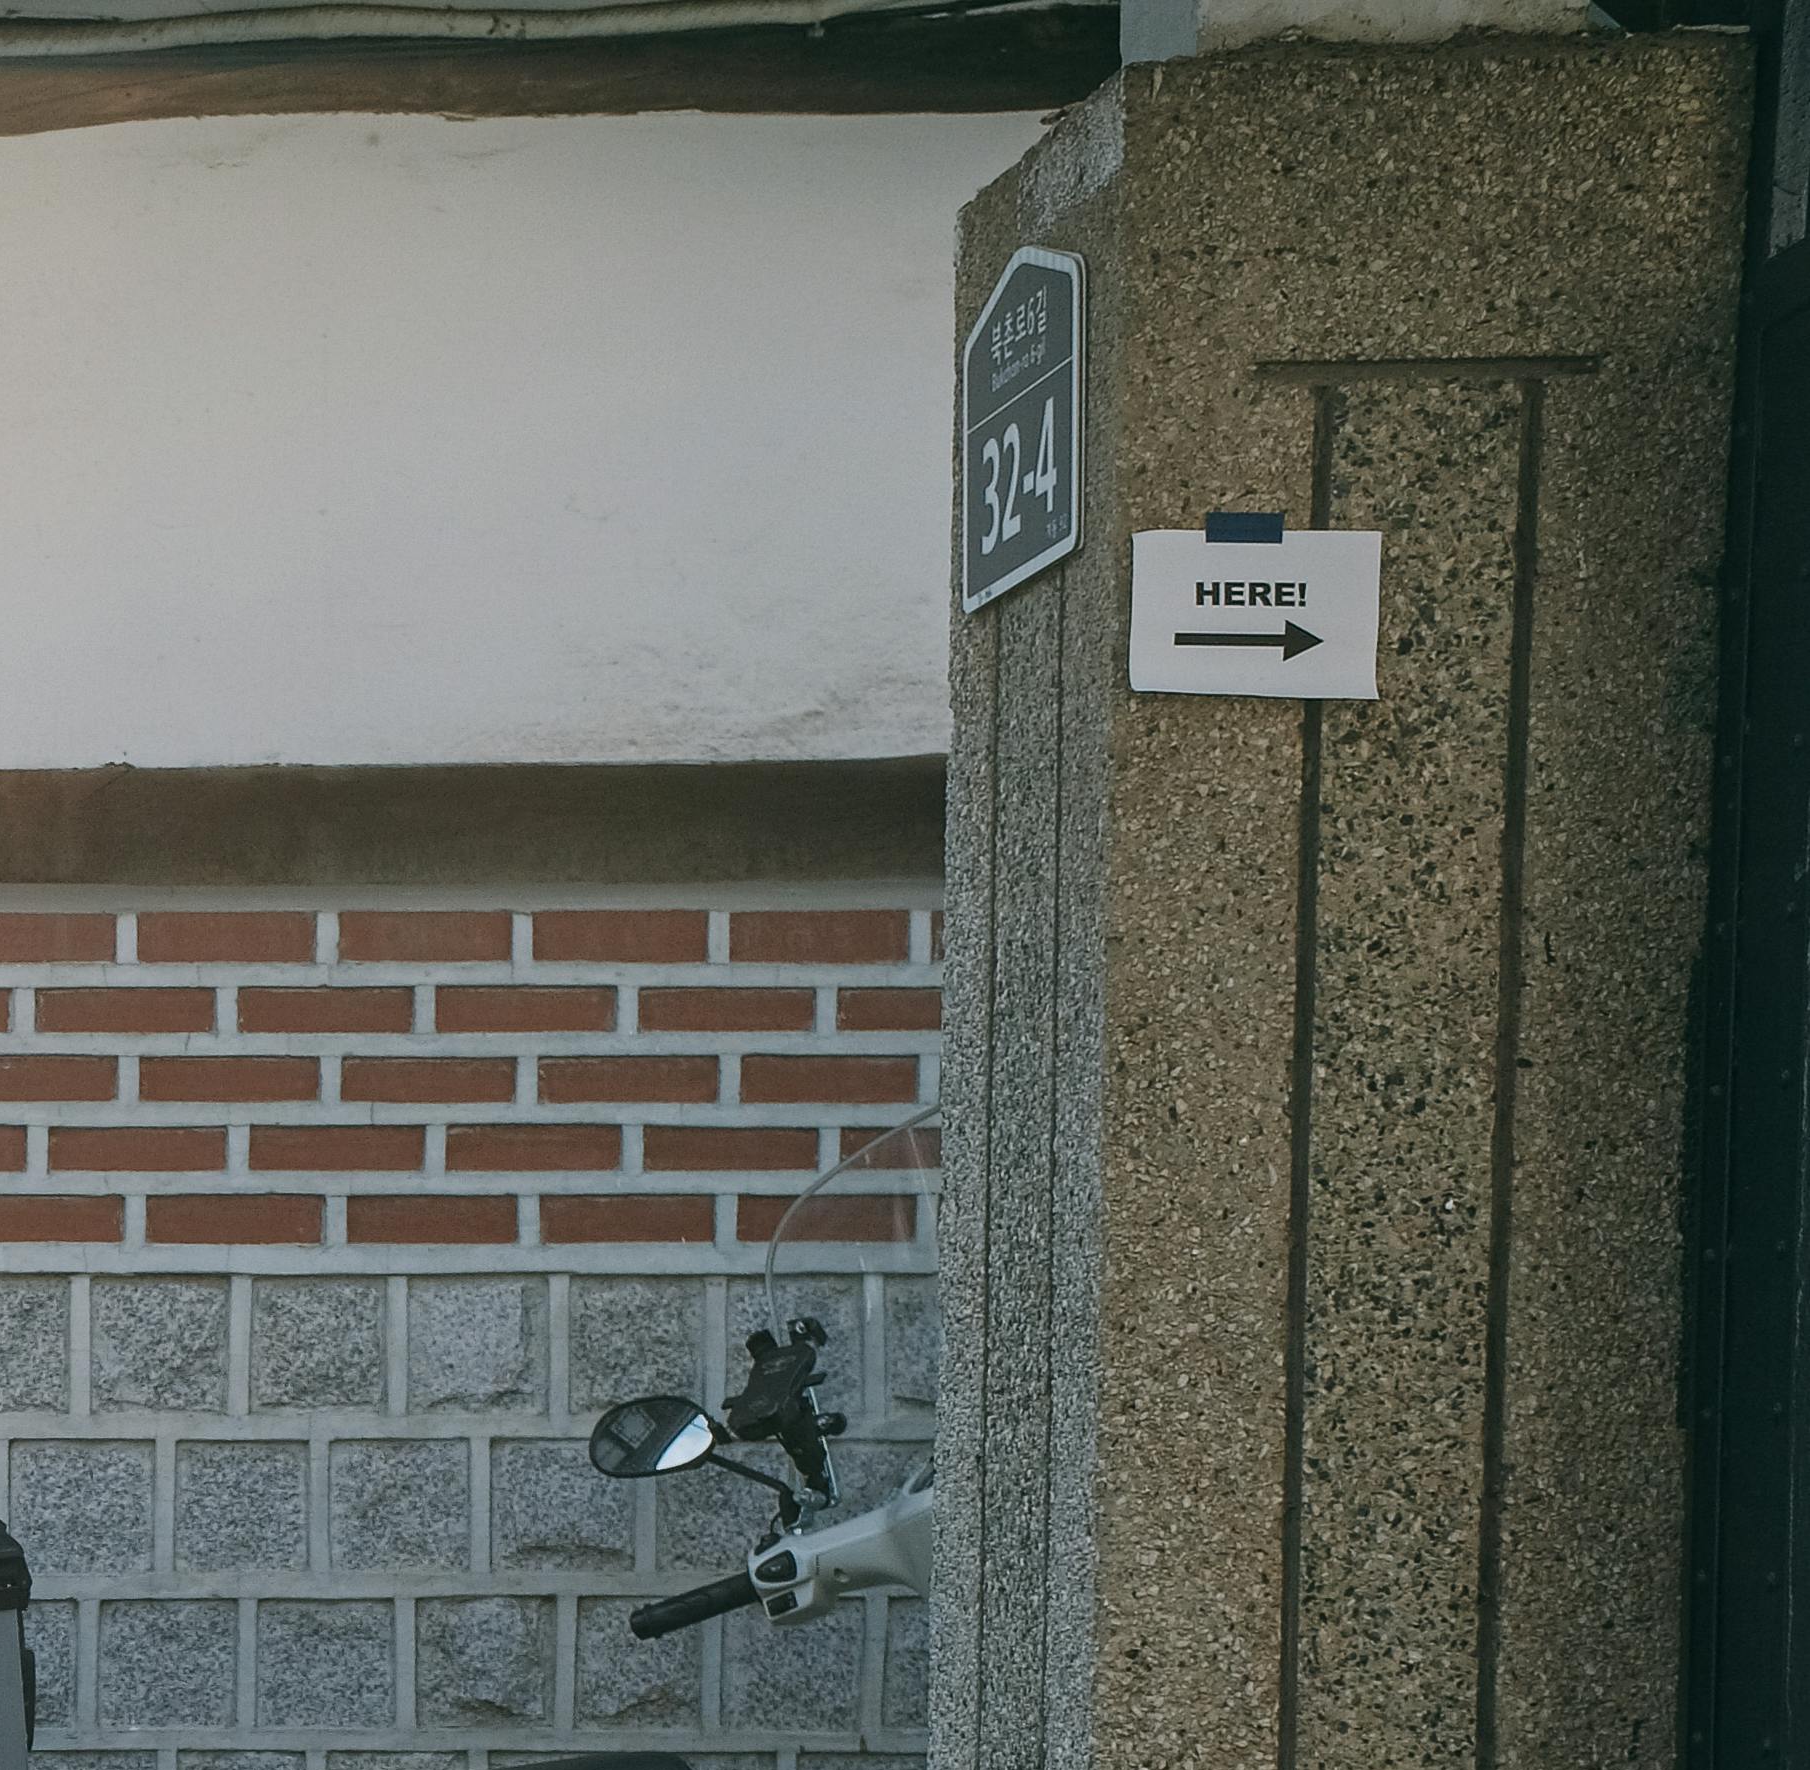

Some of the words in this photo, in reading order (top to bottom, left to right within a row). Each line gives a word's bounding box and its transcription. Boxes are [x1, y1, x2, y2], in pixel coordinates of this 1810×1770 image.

[990, 284, 1048, 366] 북촌로6길
[980, 397, 1058, 556] 32-4
[1195, 580, 1308, 608] HERE!
